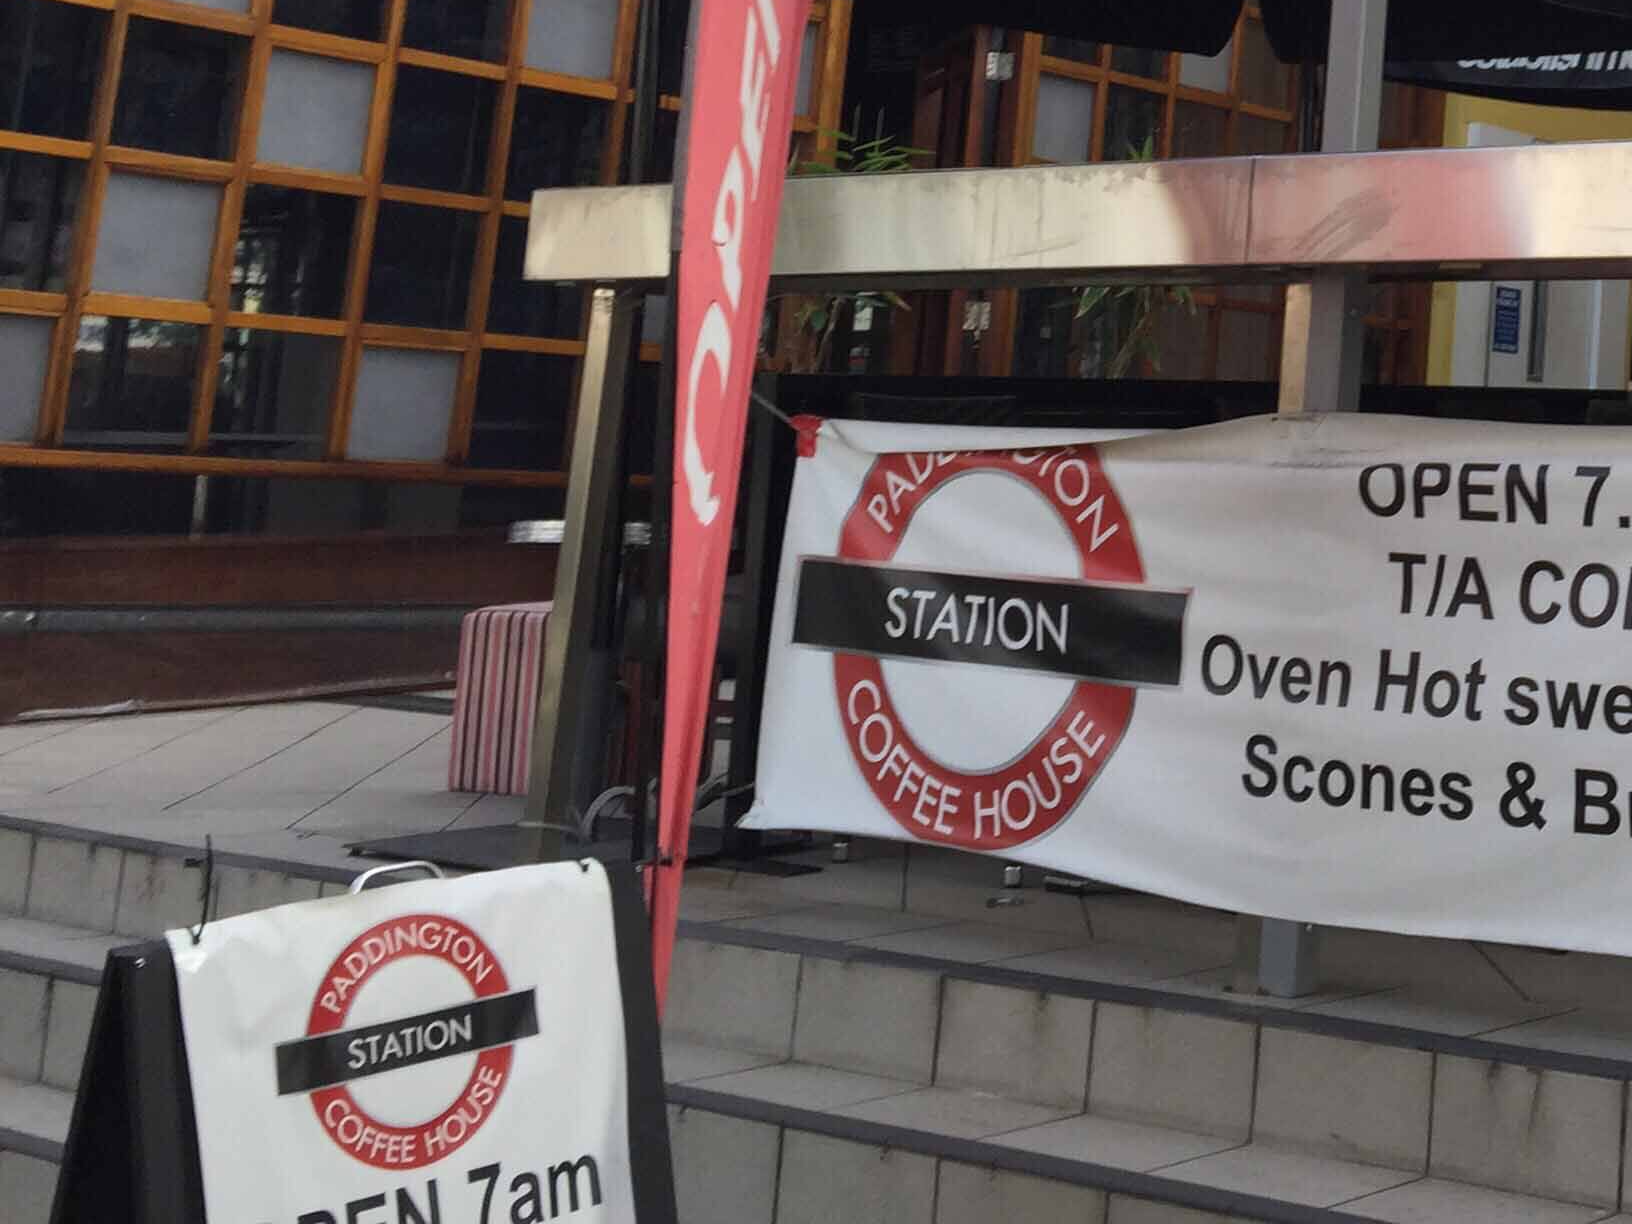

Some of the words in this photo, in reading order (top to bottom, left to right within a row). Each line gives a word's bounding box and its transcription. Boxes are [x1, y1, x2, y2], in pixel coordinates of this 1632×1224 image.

[1359, 462, 1550, 528] OPEN
[885, 587, 1072, 655] STATION
[1389, 551, 1494, 622] T/A
[1201, 633, 1351, 709] Oven
[1374, 649, 1486, 722] Hot
[848, 679, 962, 836] COFFEE
[974, 710, 1105, 839] HOUSE
[1242, 734, 1473, 822] Scones
[1500, 762, 1548, 830] &
[320, 921, 495, 1014] PADDINGTON
[347, 1014, 473, 1069] STATION
[324, 1099, 416, 1164] COFFEE
[424, 1066, 502, 1157] HOUSE
[467, 1153, 602, 1224] 7am
